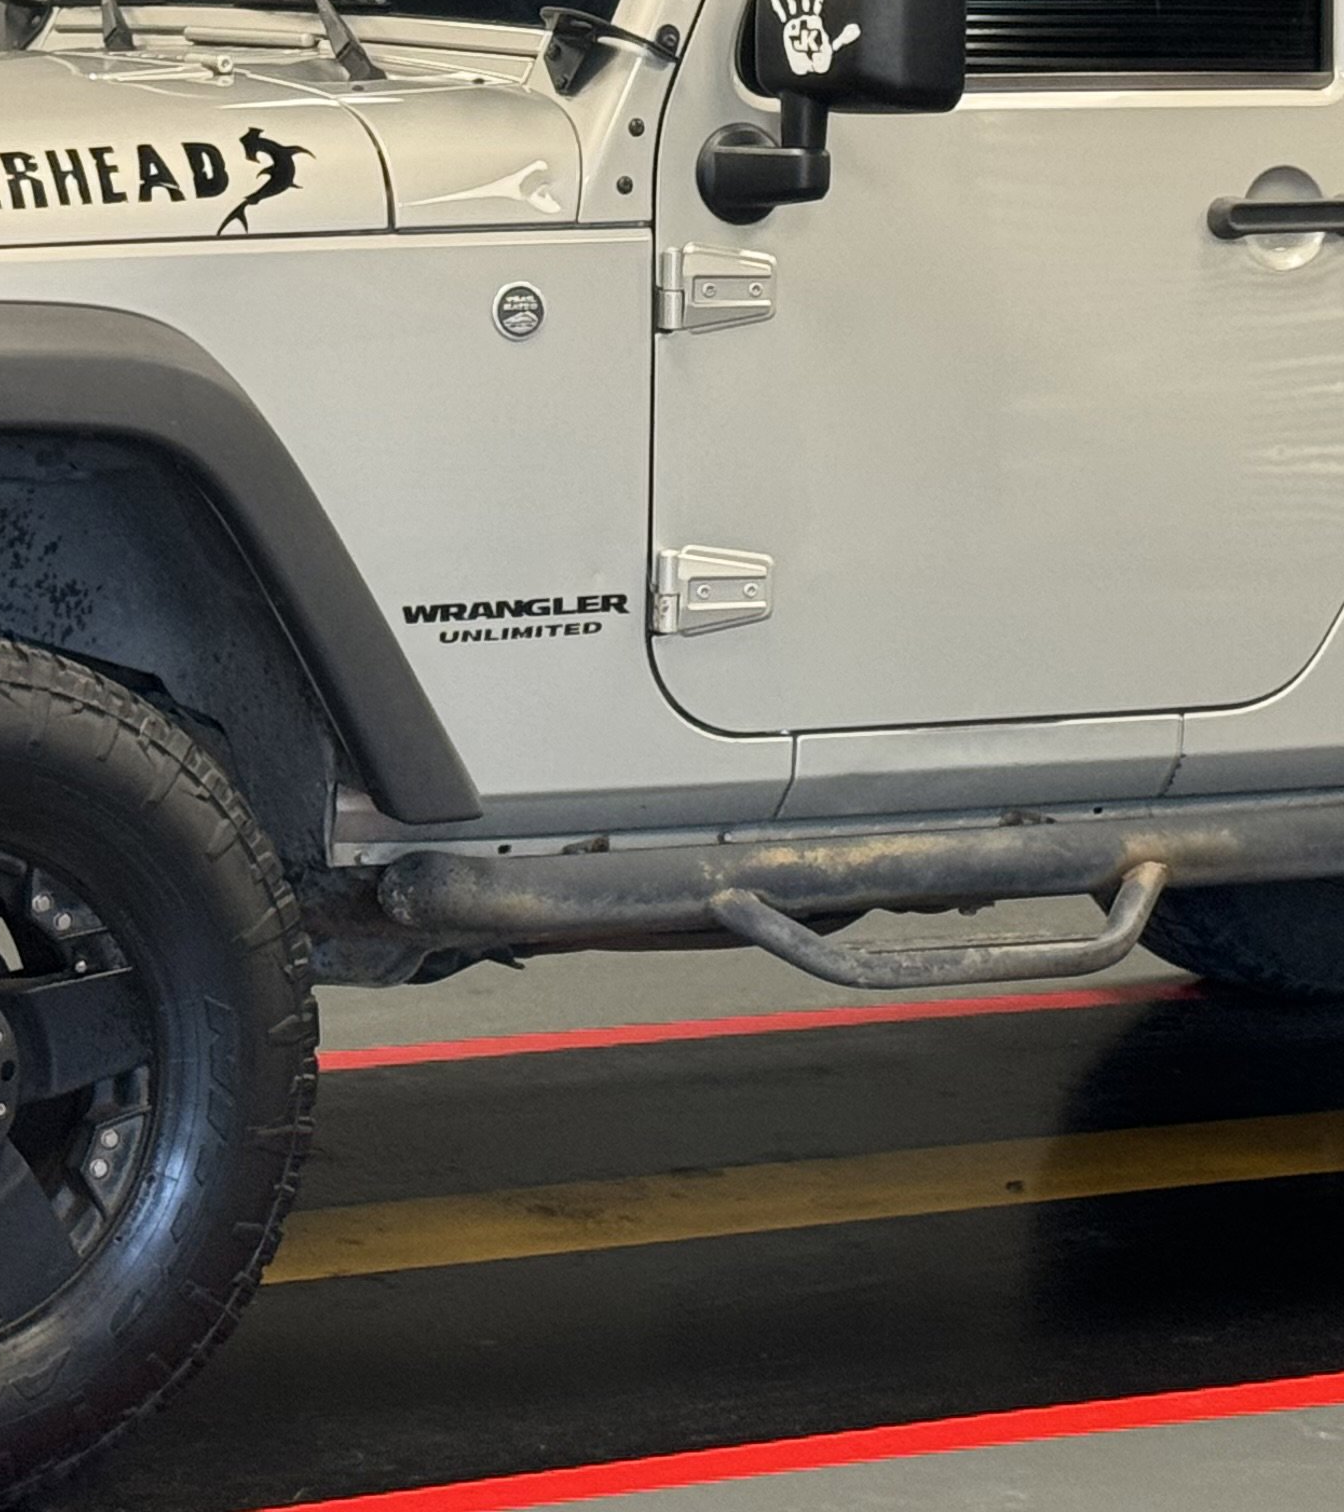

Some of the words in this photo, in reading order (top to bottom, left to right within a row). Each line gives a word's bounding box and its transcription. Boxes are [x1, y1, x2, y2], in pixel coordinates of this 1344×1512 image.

[792, 28, 820, 52] JK
[402, 593, 630, 624] WRANGLER
[439, 621, 603, 644] UNLIMITED
